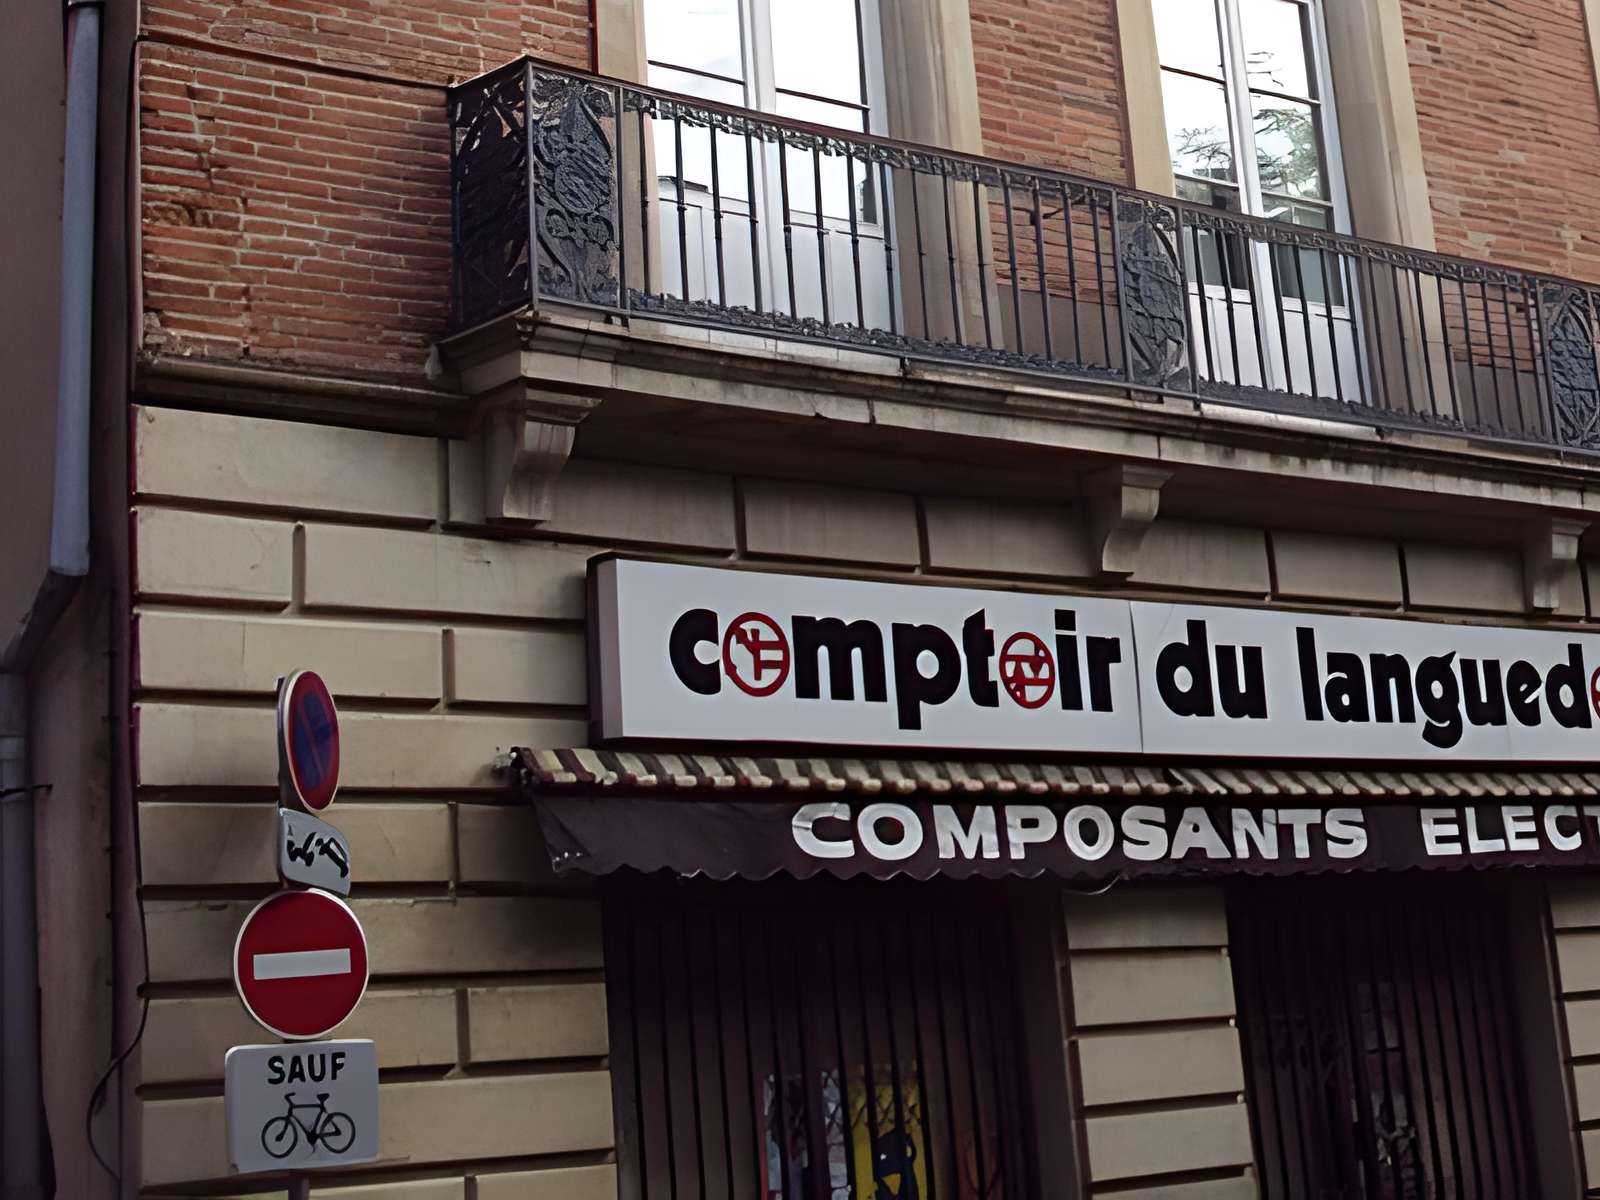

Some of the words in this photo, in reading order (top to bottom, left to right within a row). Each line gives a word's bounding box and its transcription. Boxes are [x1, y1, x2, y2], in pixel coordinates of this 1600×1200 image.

[670, 608, 1121, 730] comptoir
[1156, 620, 1267, 719] du
[792, 802, 1368, 861] COMPOSANTS
[268, 1051, 346, 1084] SAUF
